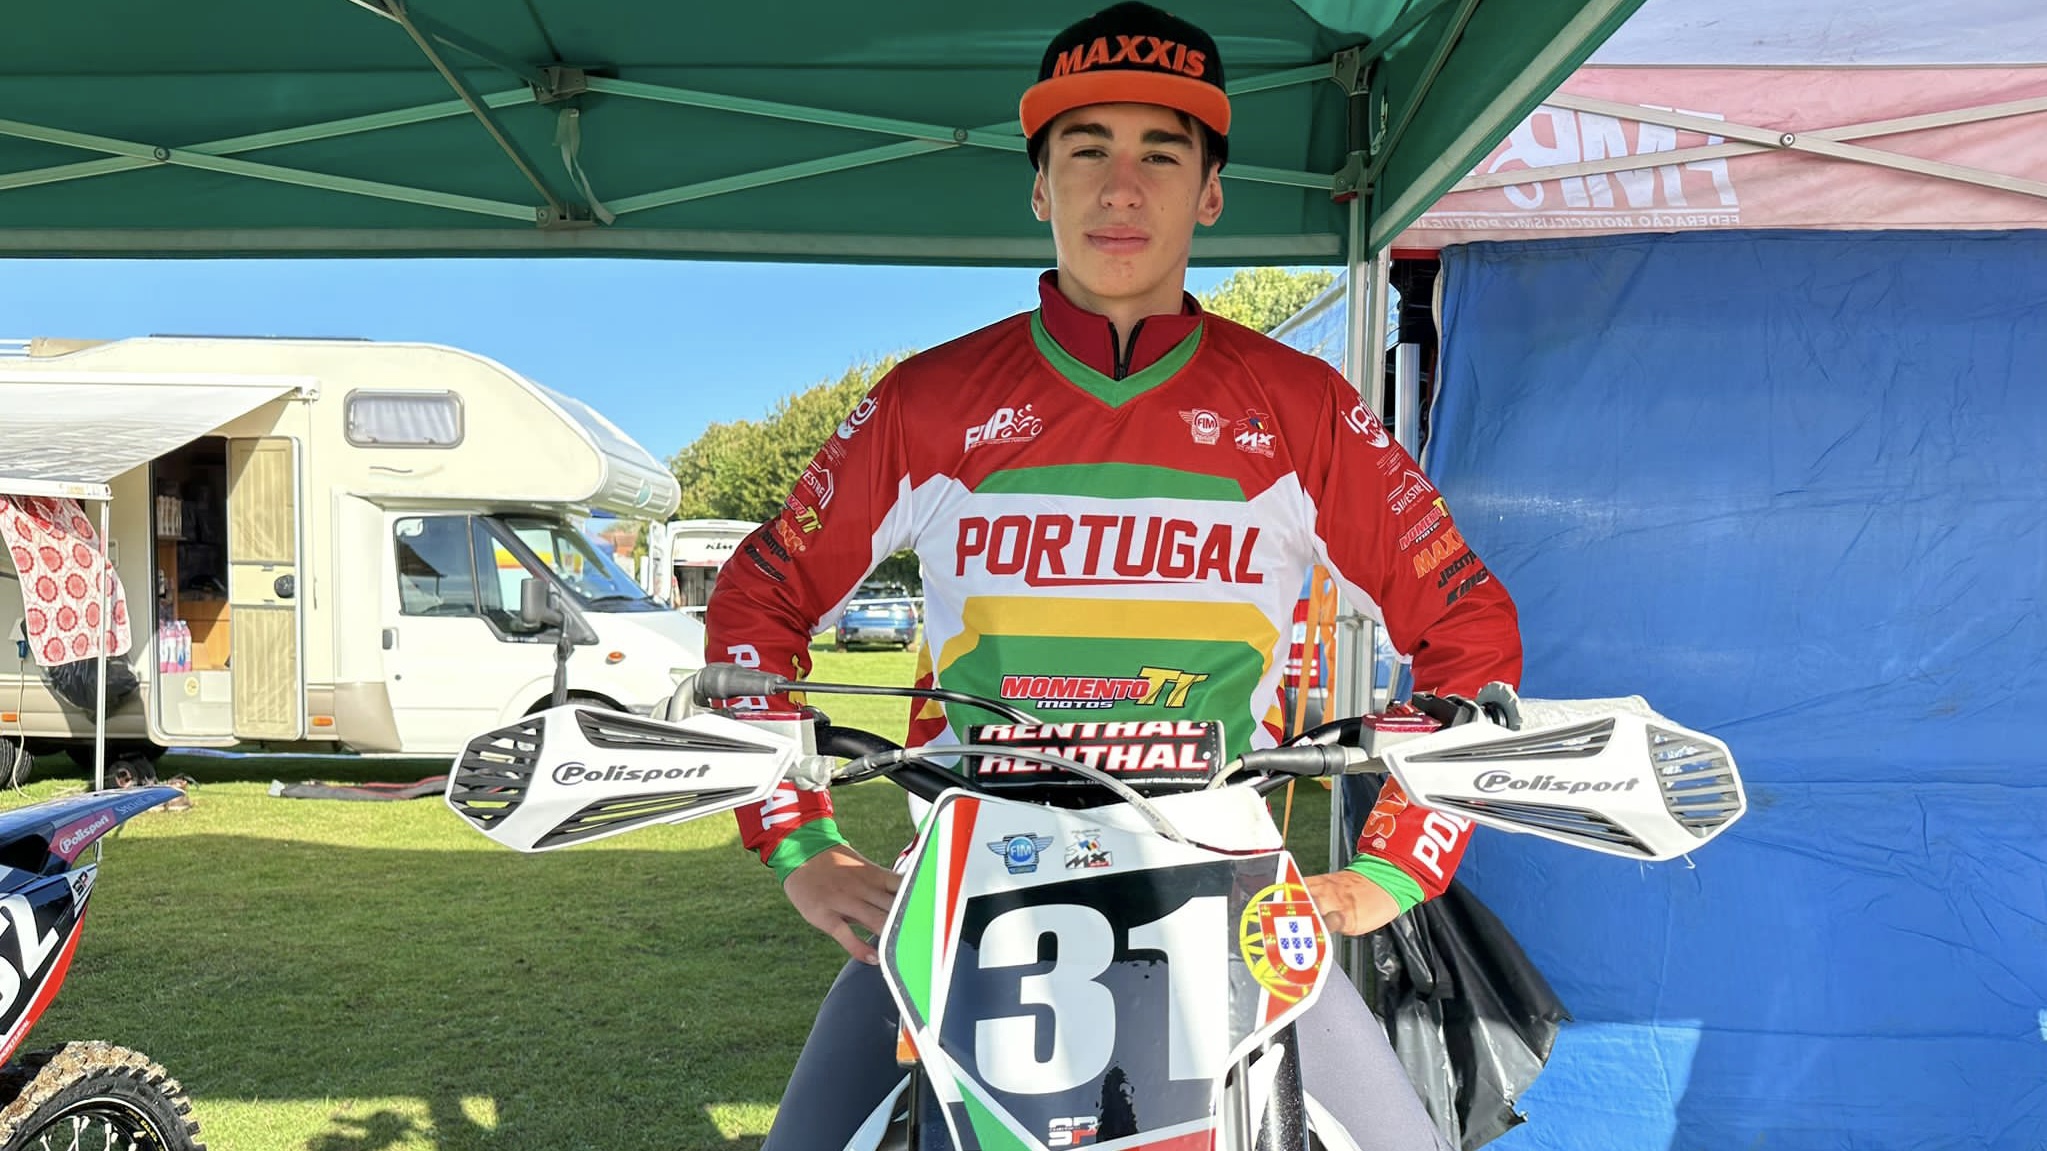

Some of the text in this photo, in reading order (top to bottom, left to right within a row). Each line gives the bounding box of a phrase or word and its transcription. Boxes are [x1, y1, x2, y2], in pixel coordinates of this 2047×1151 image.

[1052, 35, 1206, 78] MAXXIS
[1197, 417, 1215, 429] FIM
[955, 513, 1264, 587] PORTUGAL
[1001, 666, 1209, 708] MOMENTO TT
[1036, 699, 1115, 710] MOTOS
[552, 761, 712, 786] Polisport
[1473, 770, 1640, 794] Polisport
[60, 814, 110, 853] Polisport
[1010, 844, 1033, 858] FIM
[1065, 851, 1110, 868] MX
[975, 896, 1229, 1095] 31
